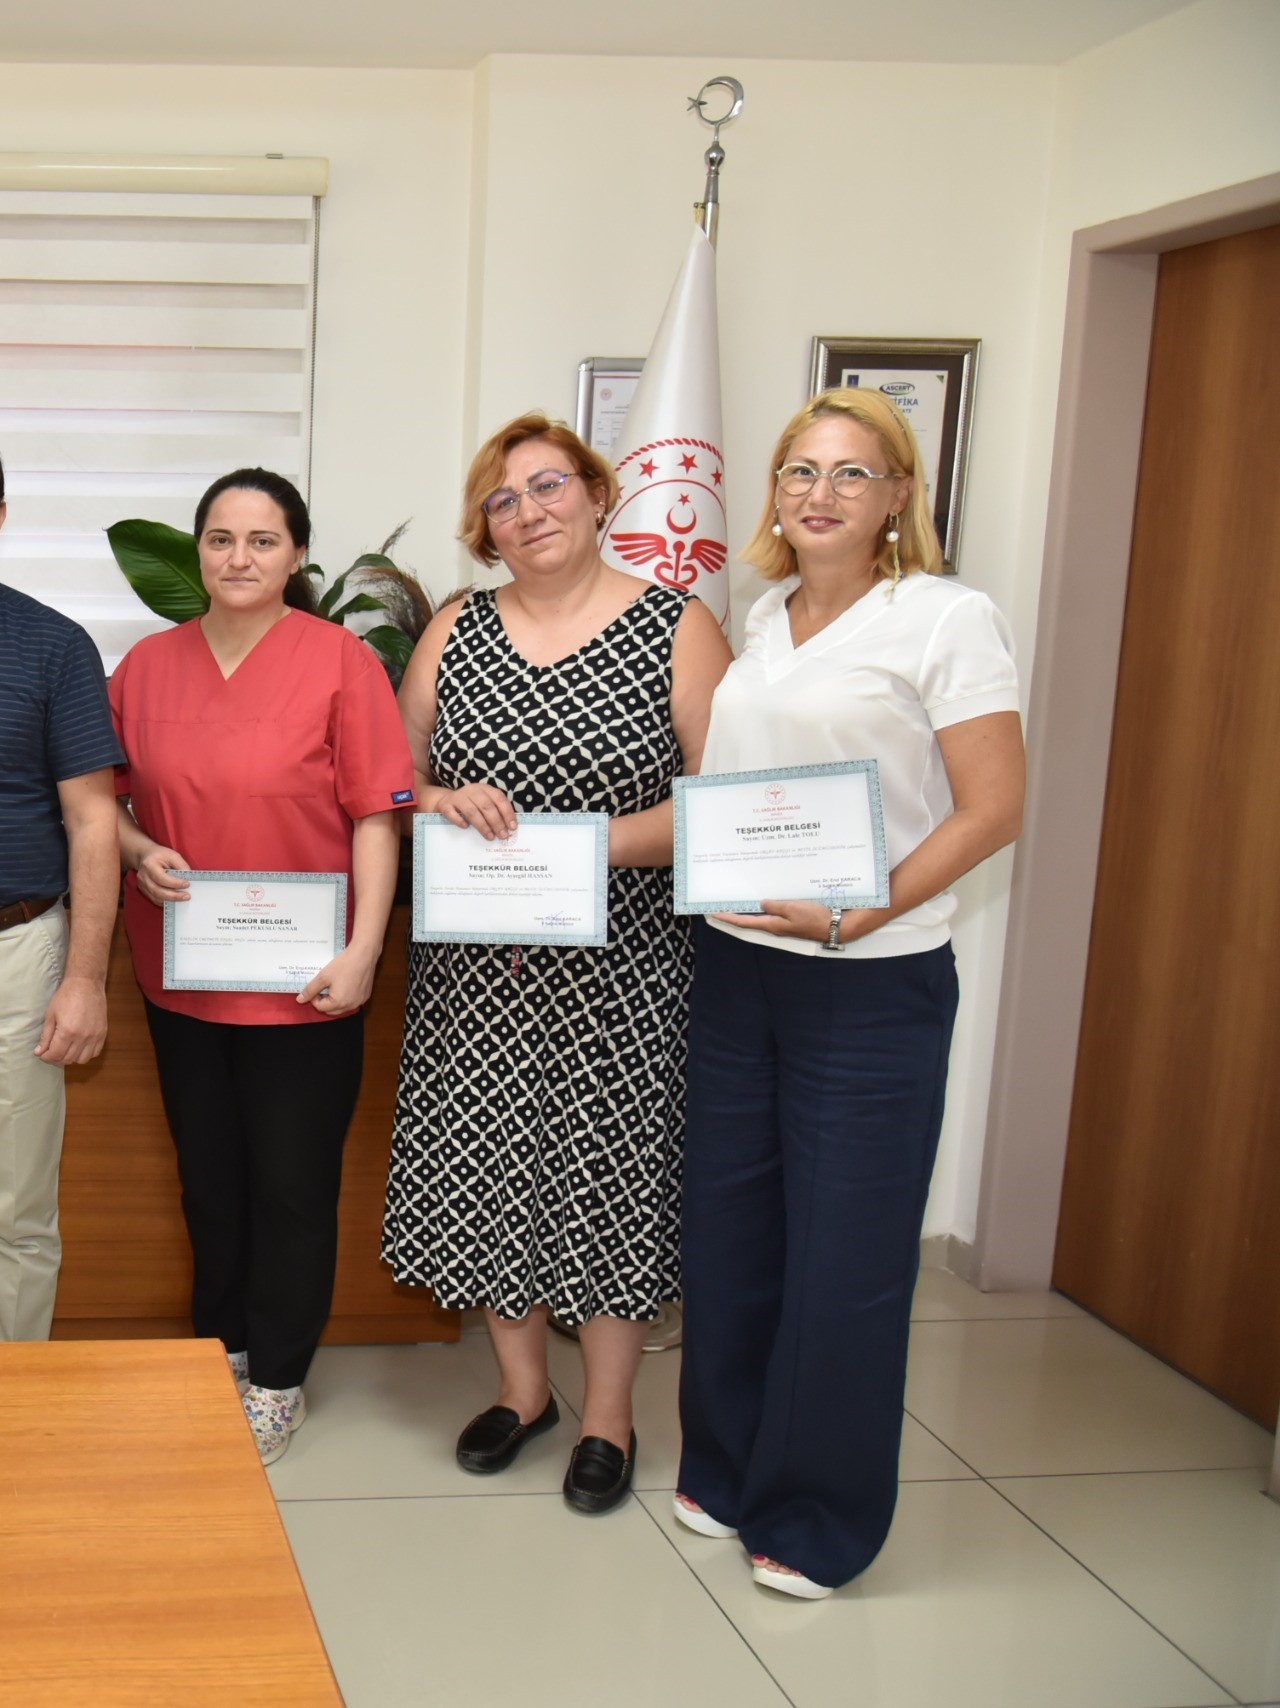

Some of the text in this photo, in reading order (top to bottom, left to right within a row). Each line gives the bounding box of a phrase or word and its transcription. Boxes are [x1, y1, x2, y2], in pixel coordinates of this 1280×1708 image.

[894, 397, 919, 406] İFİKA
[736, 821, 820, 834] TEŞEKKÜR BELGESİ
